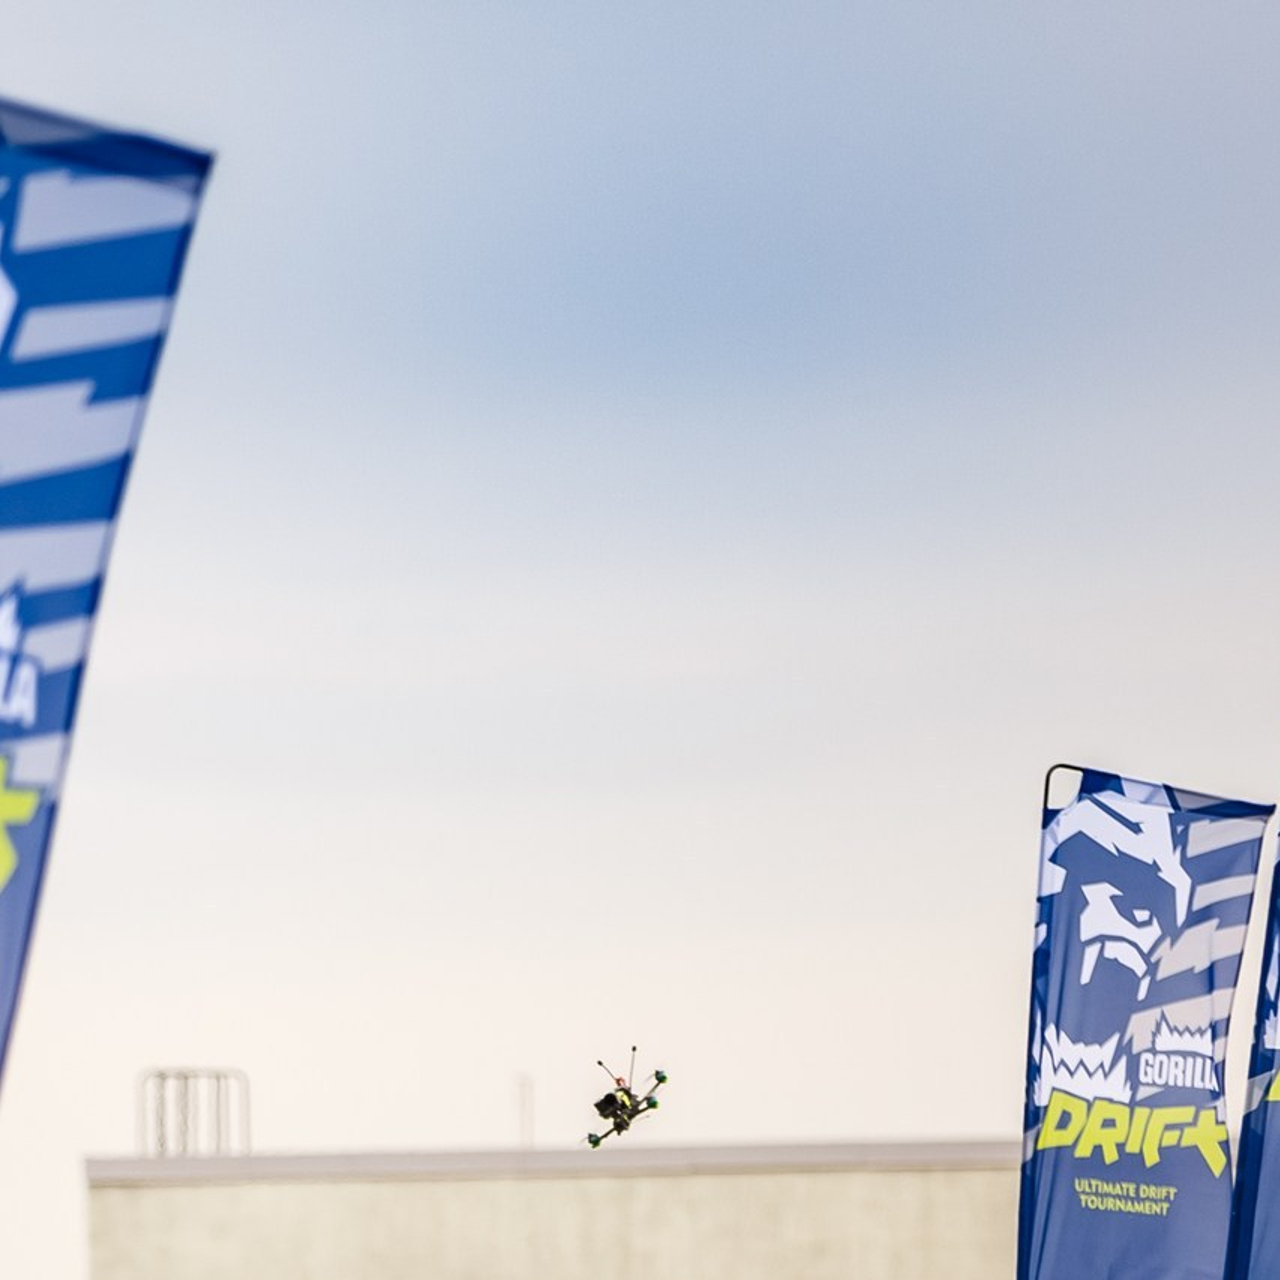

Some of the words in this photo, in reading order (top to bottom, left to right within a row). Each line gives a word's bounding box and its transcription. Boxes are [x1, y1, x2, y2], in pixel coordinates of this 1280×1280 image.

[1037, 1089, 1227, 1178] DRIFT
[1074, 1177, 1137, 1197] ULTIMATE
[1139, 1183, 1178, 1201] DRIFT
[1080, 1194, 1170, 1217] TOURNAMENT
